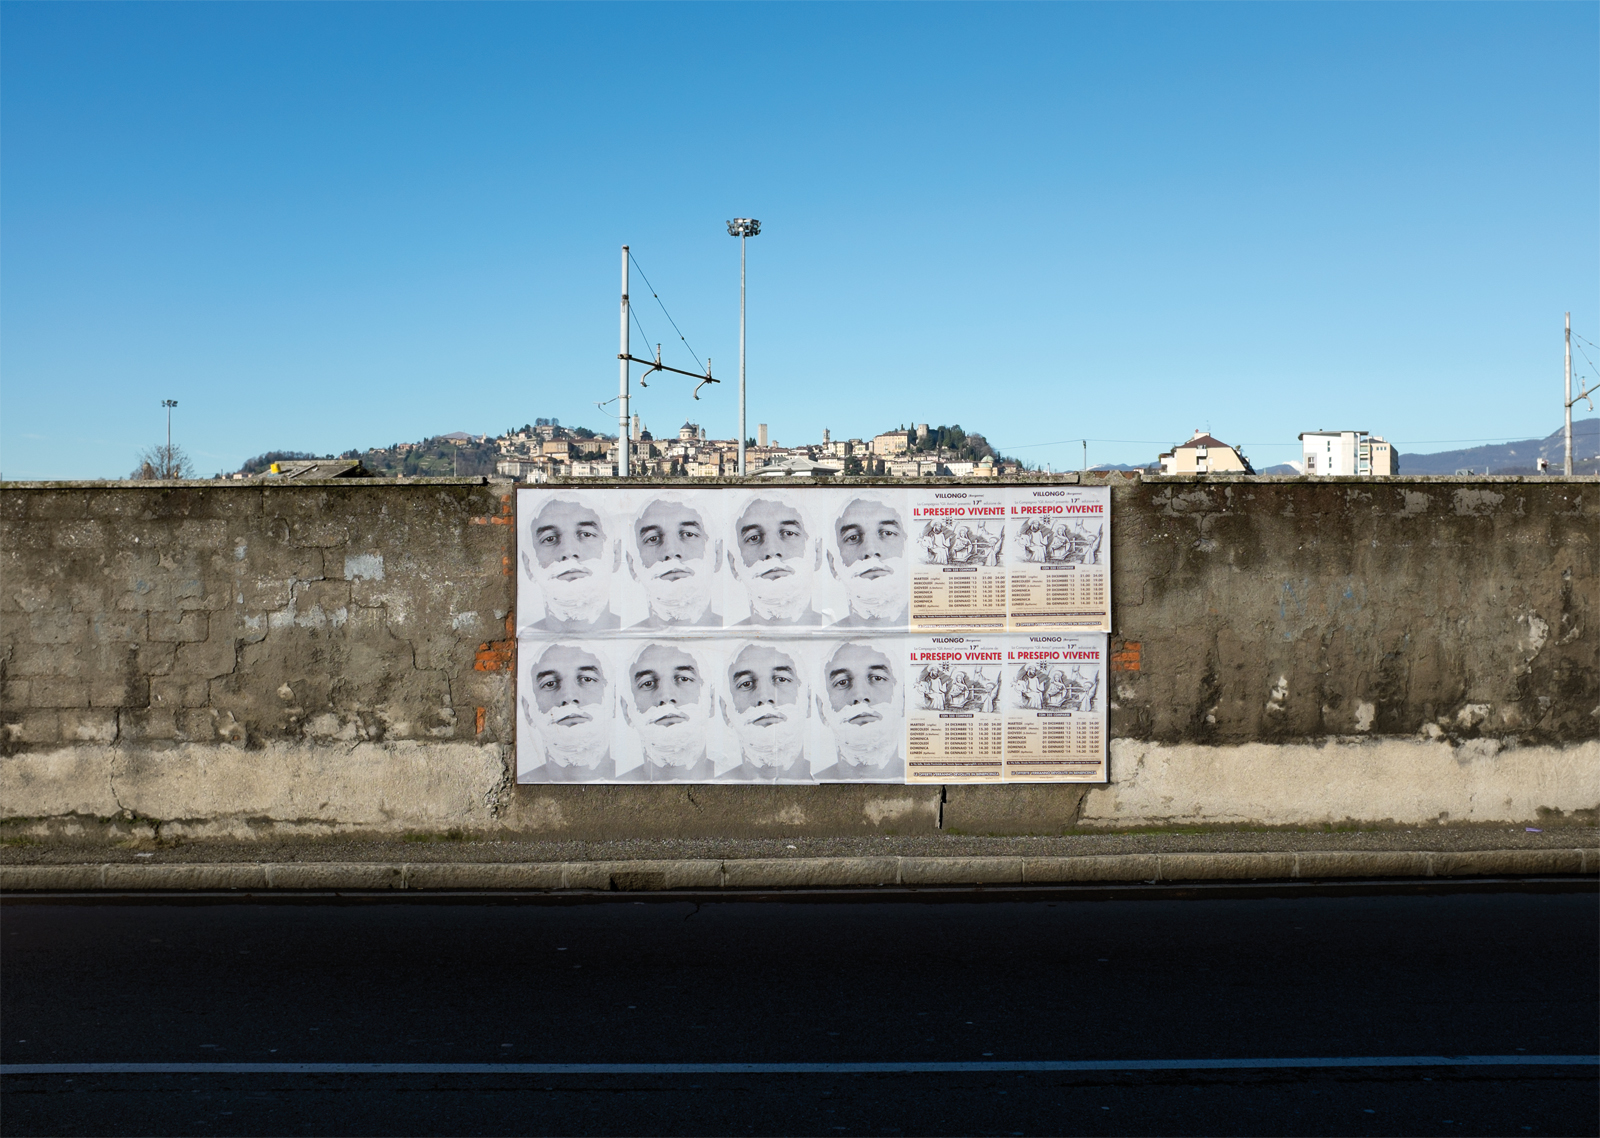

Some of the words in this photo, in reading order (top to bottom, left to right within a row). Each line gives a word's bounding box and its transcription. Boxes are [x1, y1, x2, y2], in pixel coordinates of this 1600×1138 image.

[968, 507, 1005, 515] VIVENTE
[1021, 506, 1063, 514] PRESEPIO
[1066, 505, 1103, 513] VIVENTE
